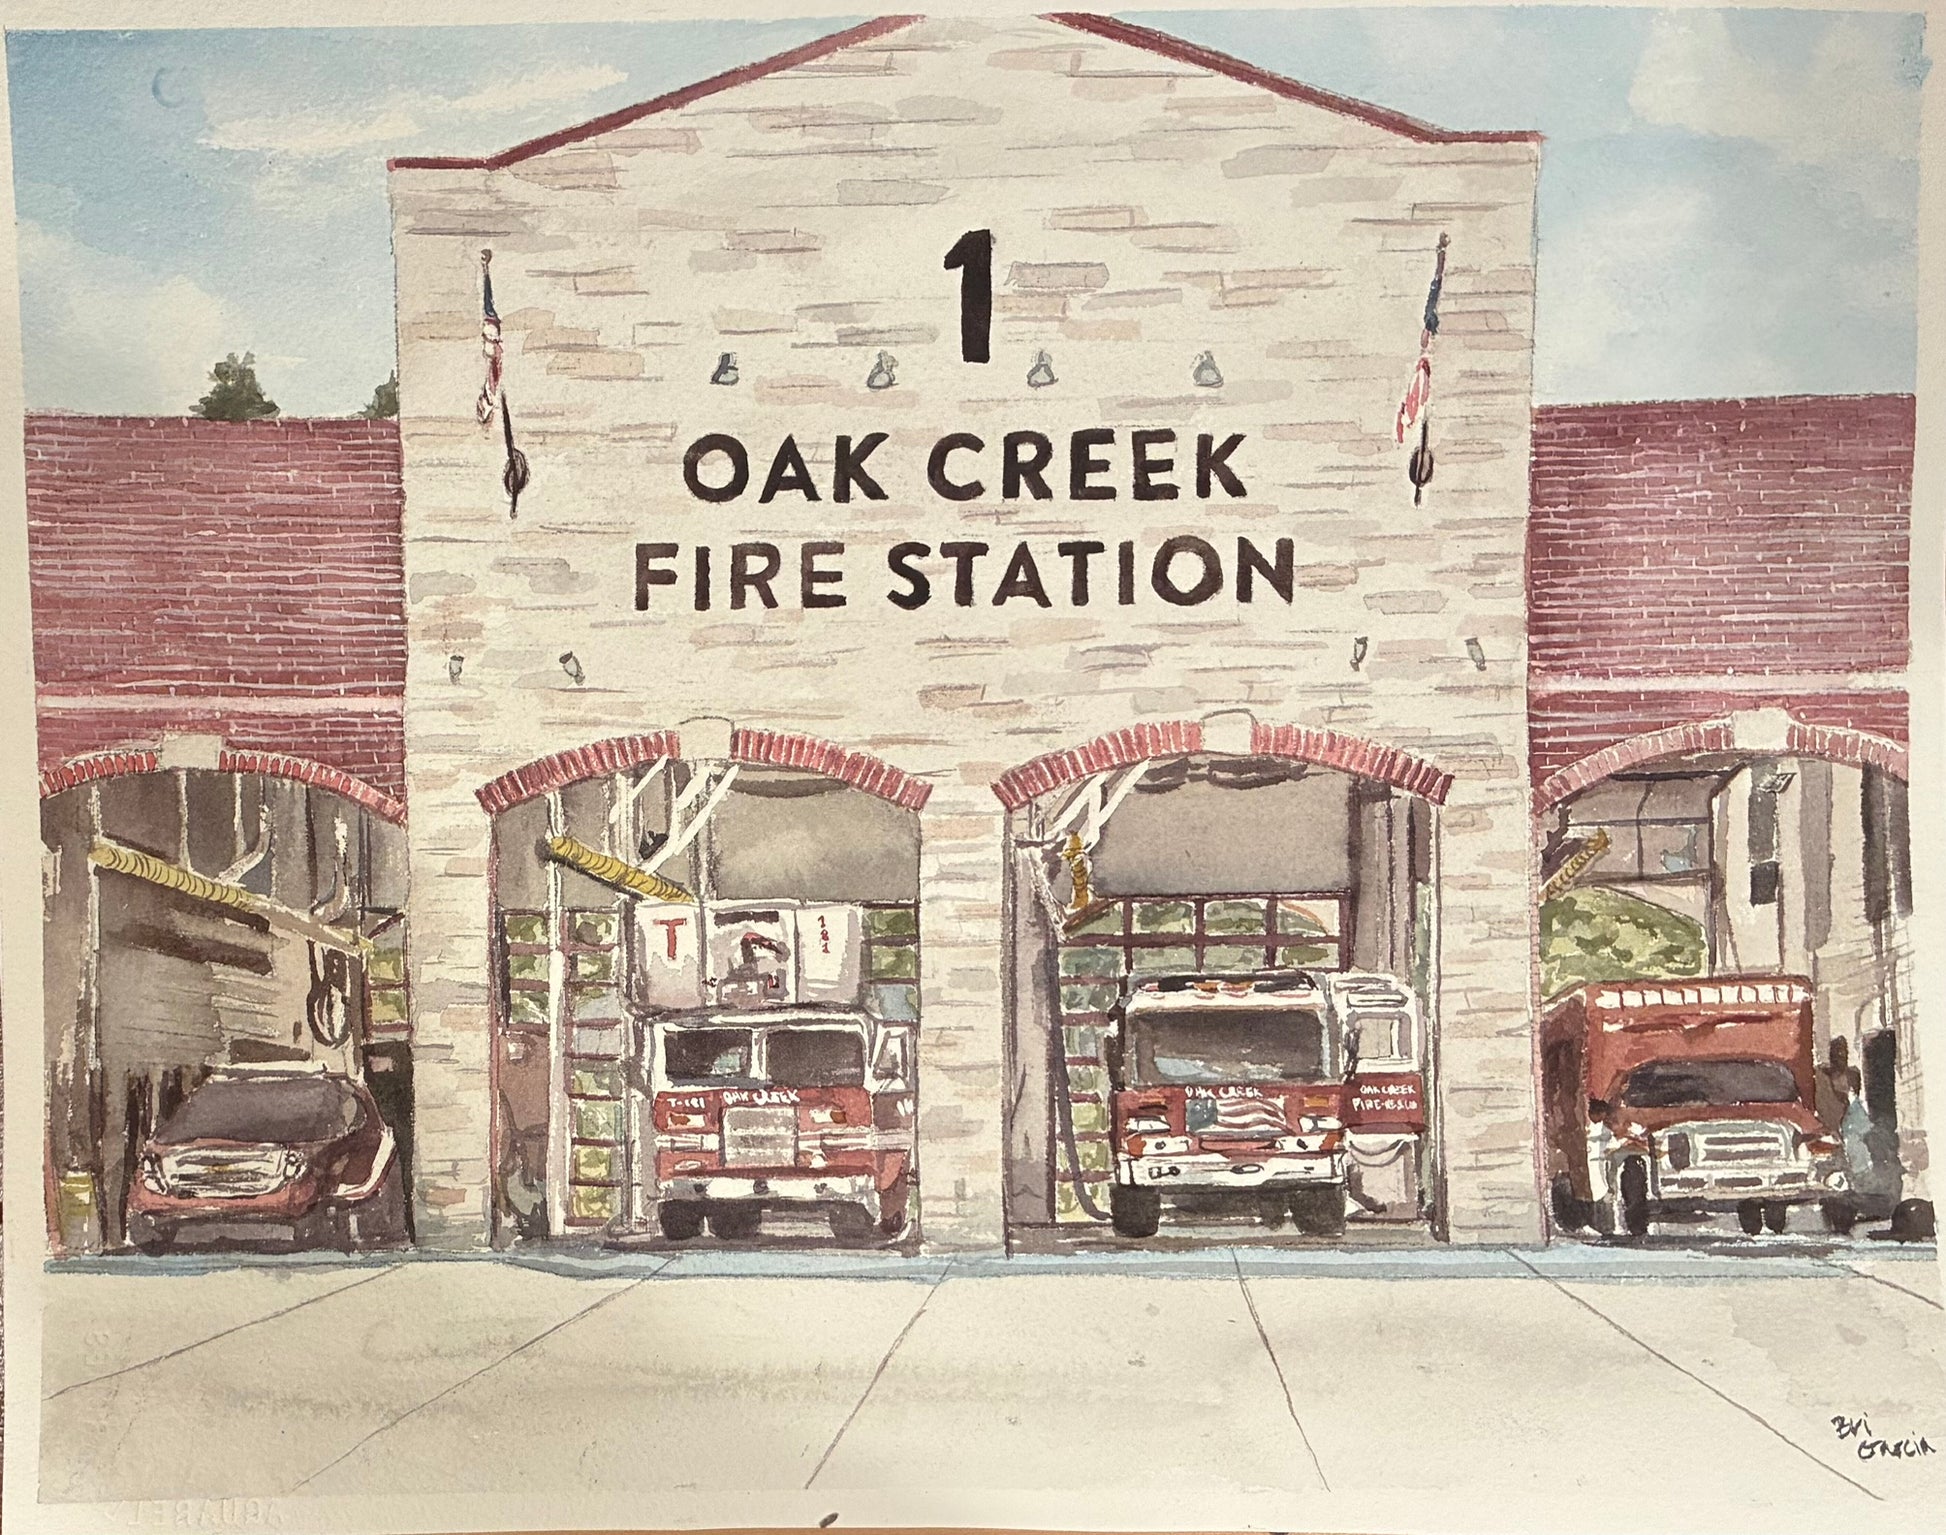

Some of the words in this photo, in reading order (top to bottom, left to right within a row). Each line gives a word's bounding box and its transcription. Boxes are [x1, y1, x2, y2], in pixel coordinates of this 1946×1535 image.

[944, 229, 992, 363] 1
[684, 433, 889, 503] OAK
[928, 429, 1247, 501] CREEK
[635, 542, 846, 611] FIRE
[887, 536, 1294, 610] STATION
[653, 917, 688, 961] T
